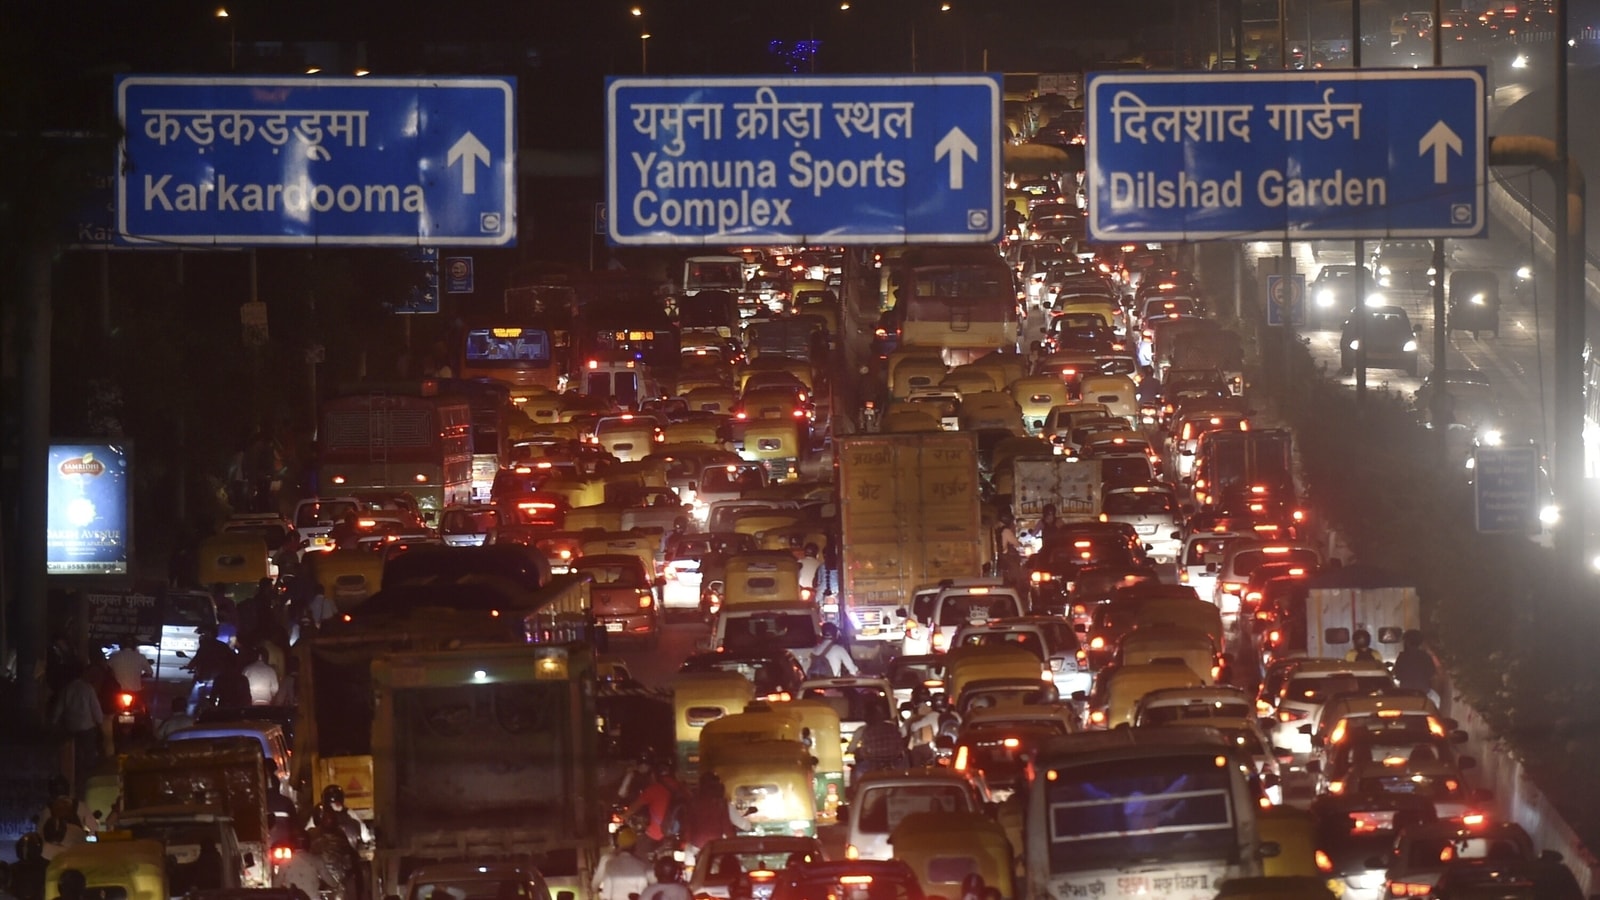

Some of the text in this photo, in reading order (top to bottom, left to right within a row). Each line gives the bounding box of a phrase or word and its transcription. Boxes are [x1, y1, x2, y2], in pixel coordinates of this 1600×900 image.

[631, 87, 914, 156] यमुना क्रीड़ा स्थल
[1110, 88, 1361, 143] दिलशाद गार्डन
[144, 174, 424, 212] Karkardooma
[631, 151, 905, 196] Yamuna Sports
[1110, 168, 1386, 209] Dilshad Garden
[633, 190, 792, 234] Complex
[86, 594, 122, 607] पायुक्त
